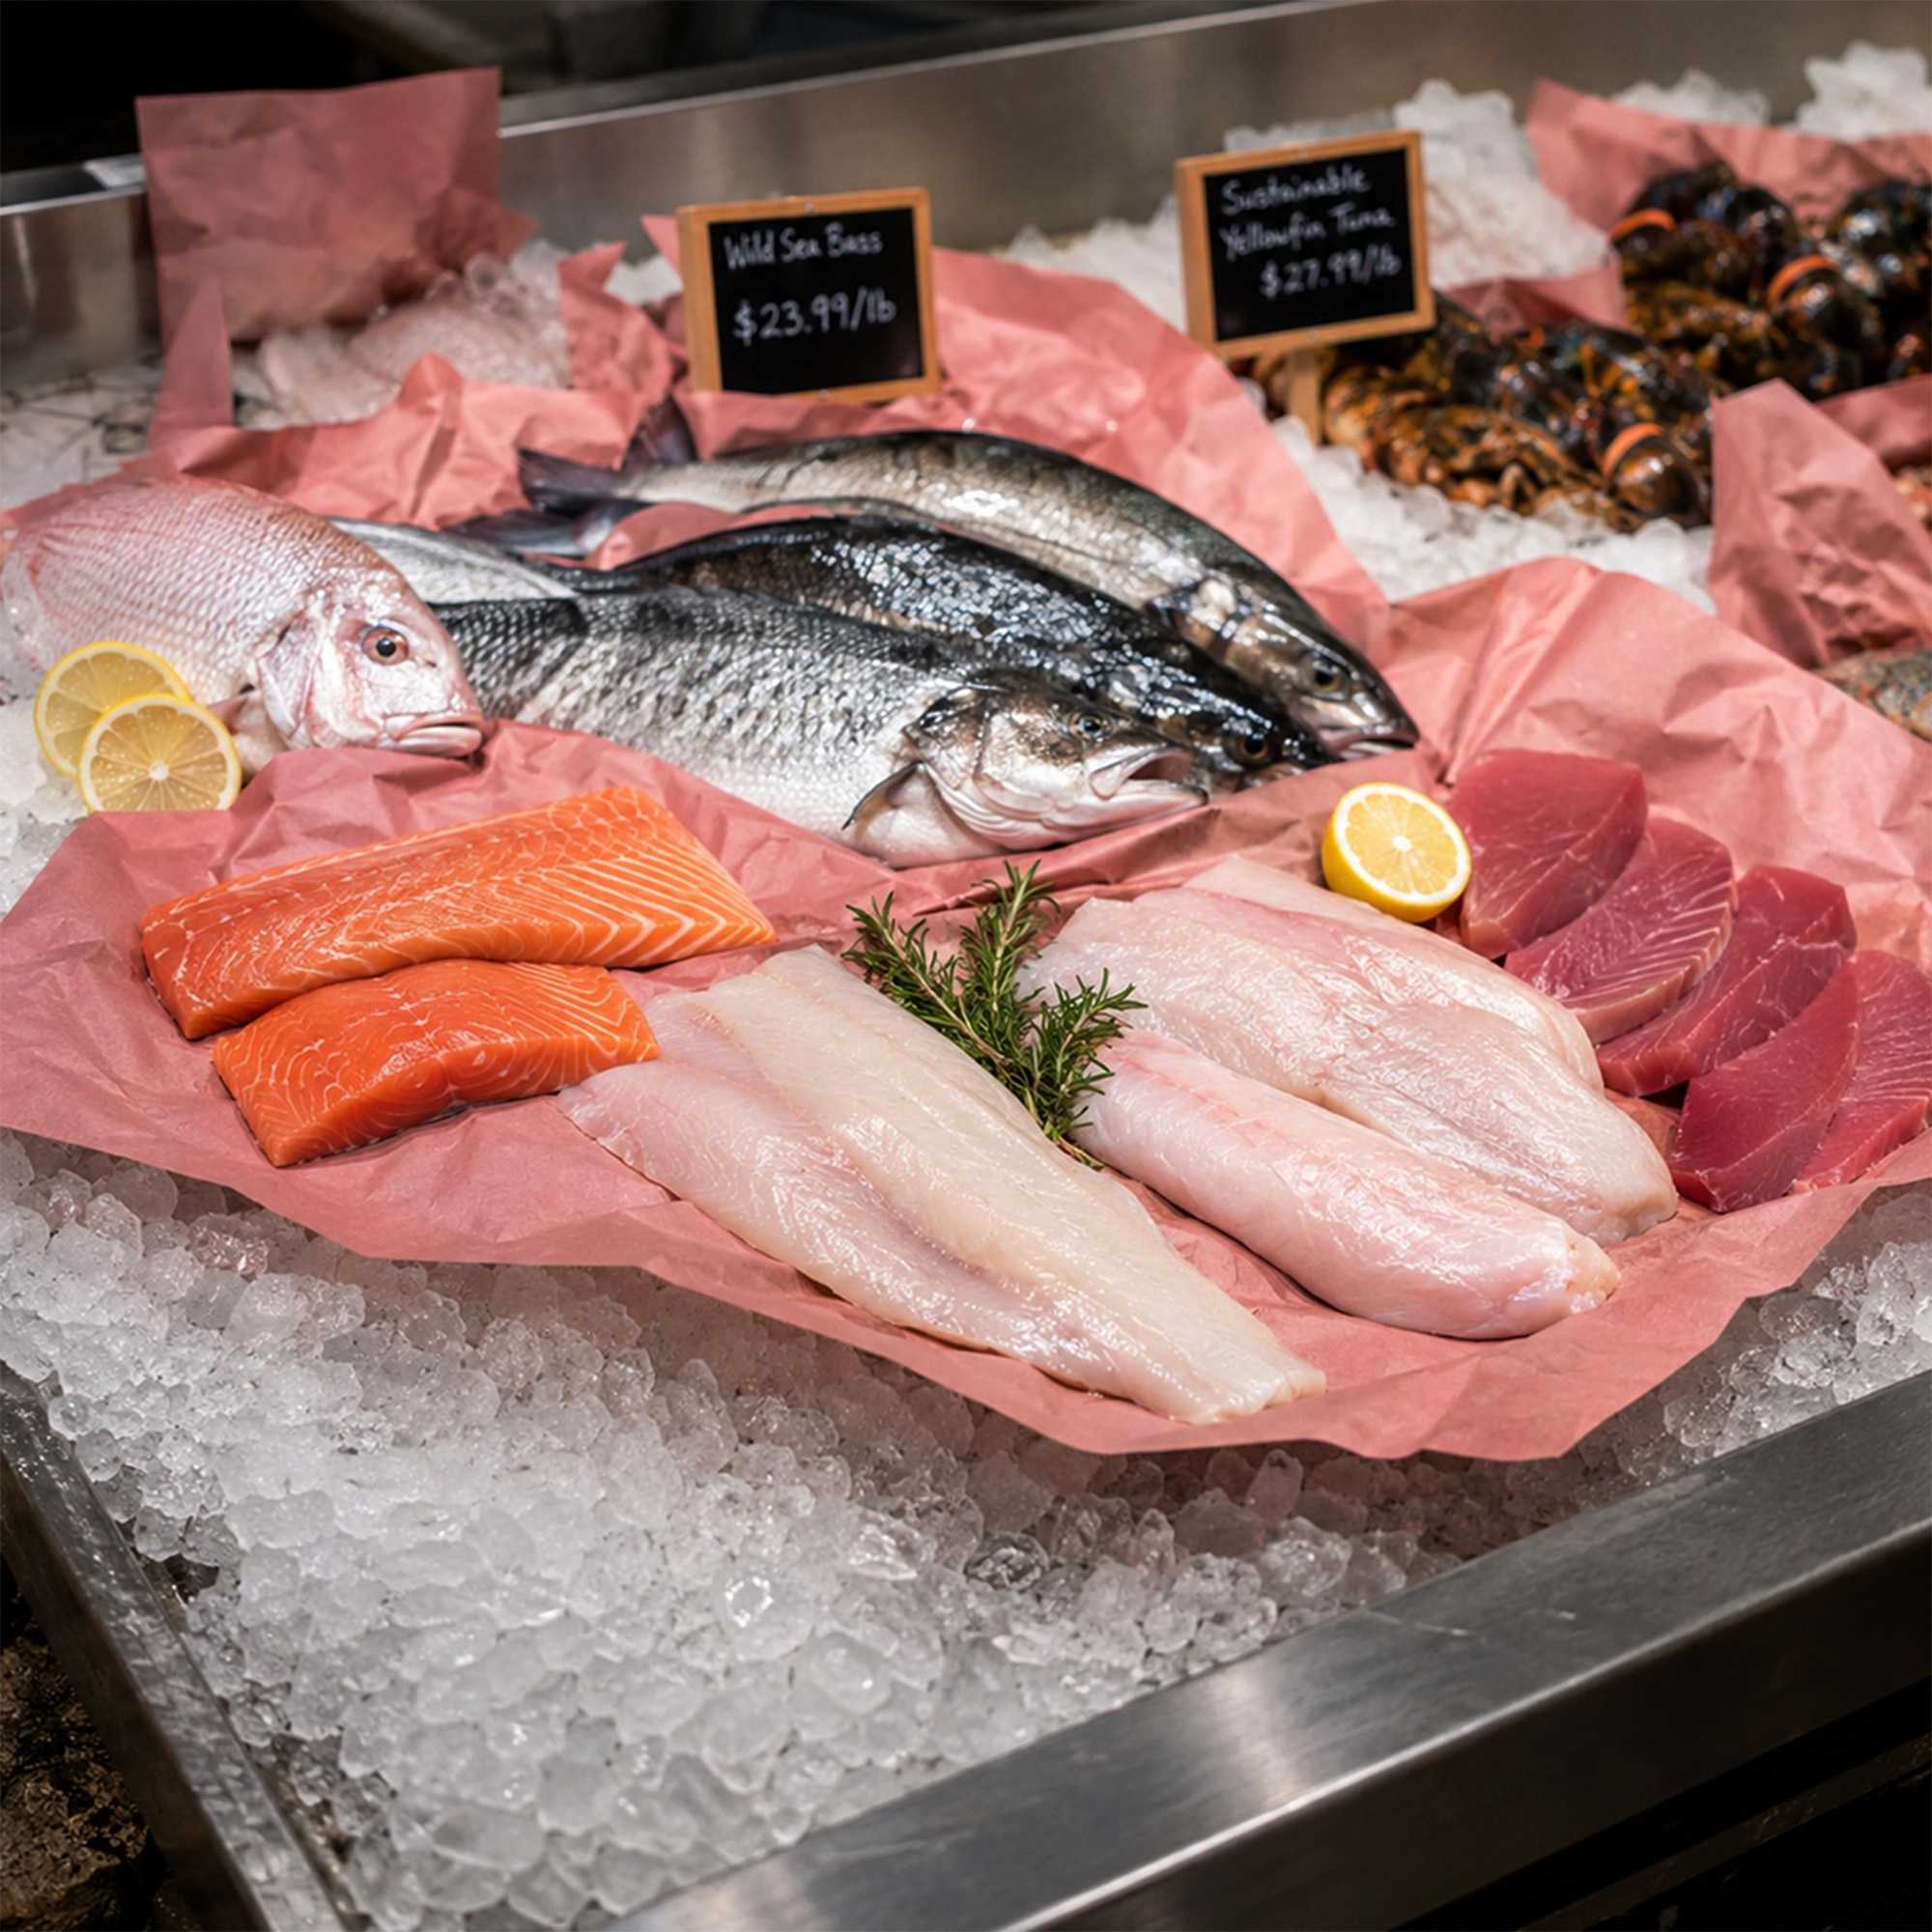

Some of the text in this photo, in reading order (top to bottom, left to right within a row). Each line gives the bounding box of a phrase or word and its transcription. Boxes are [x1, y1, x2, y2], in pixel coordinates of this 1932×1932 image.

[1221, 163, 1371, 216] Sustainable
[724, 222, 883, 270] Wild Sea Bass
[1219, 201, 1396, 262] Yellowfin Tuna
[1260, 243, 1402, 299] $27.99/lb
[733, 287, 896, 346] $23.99/lb
